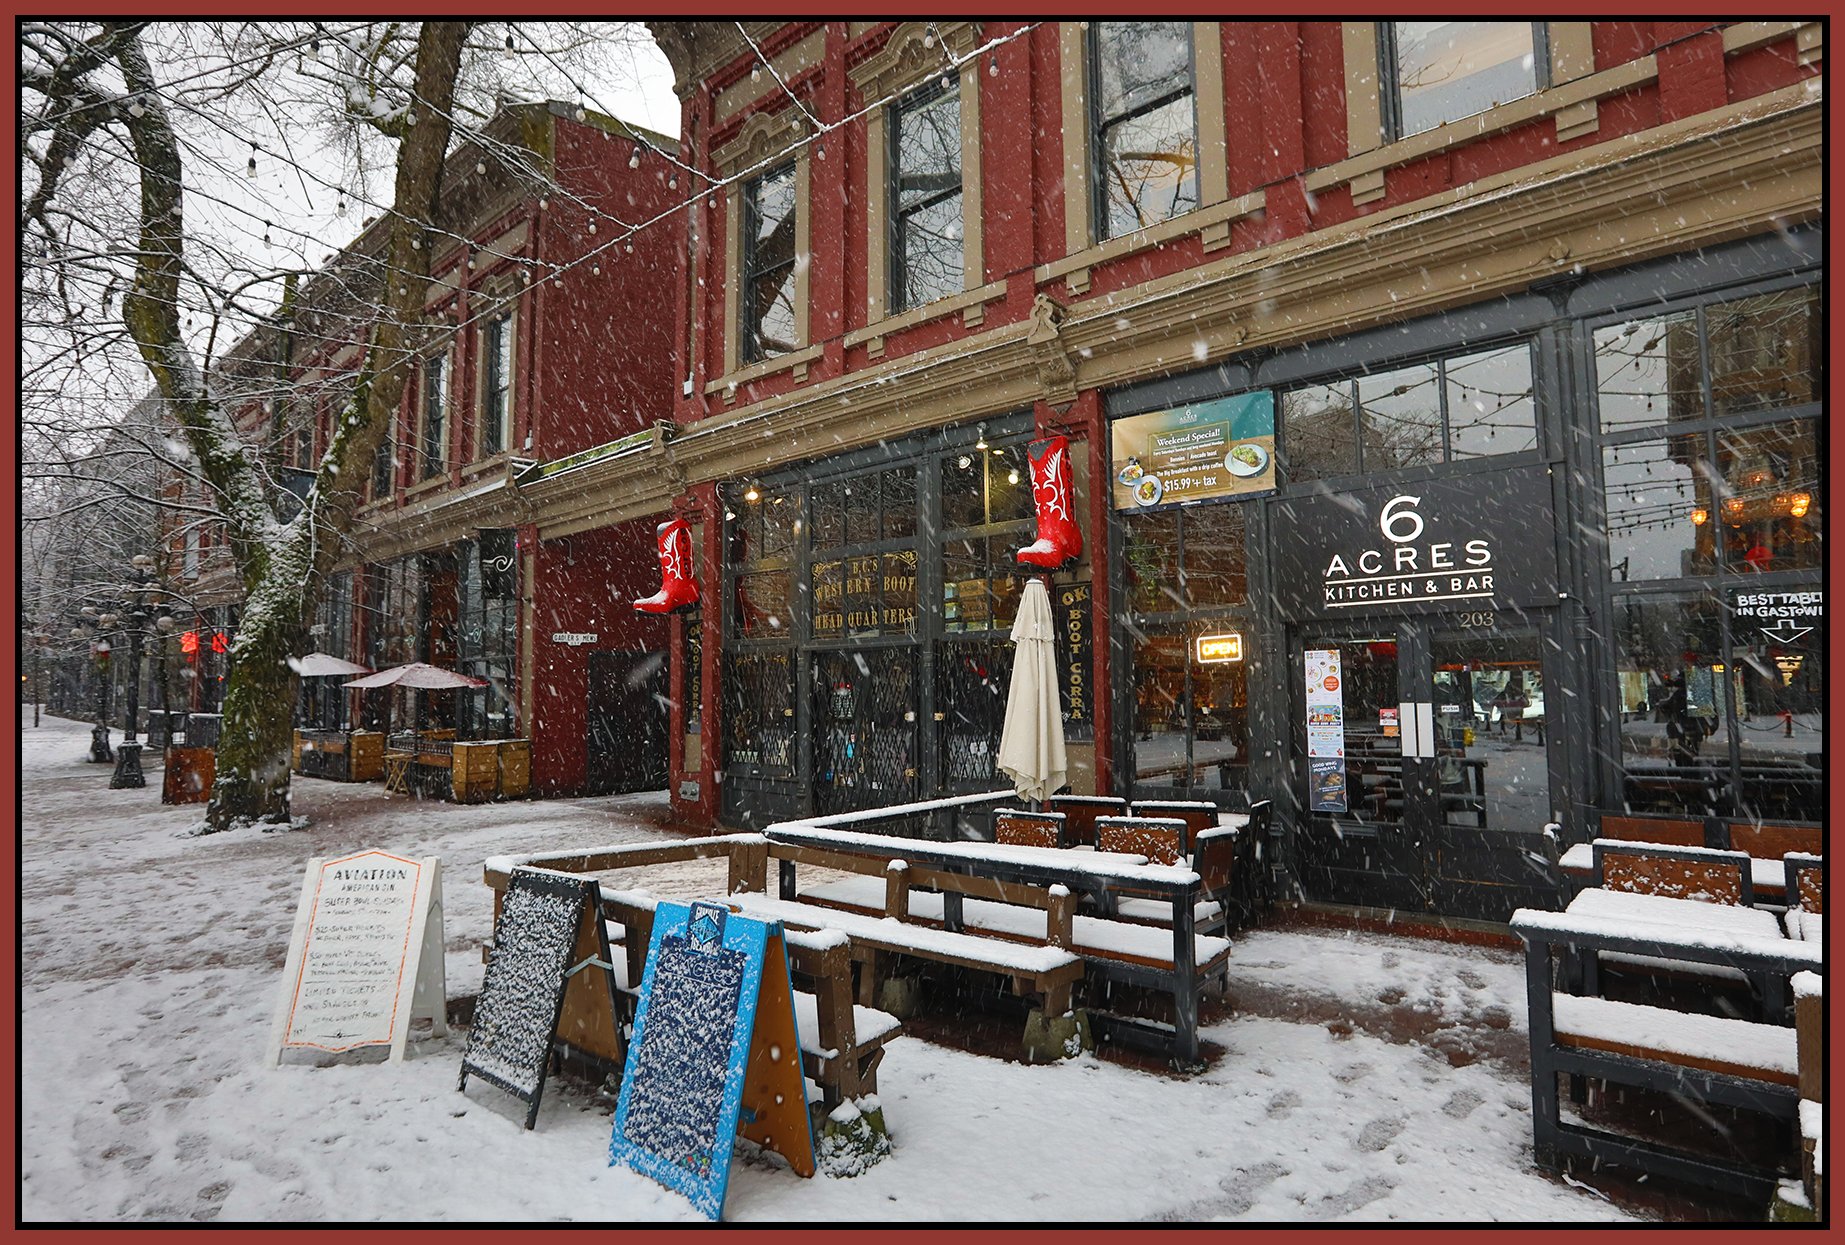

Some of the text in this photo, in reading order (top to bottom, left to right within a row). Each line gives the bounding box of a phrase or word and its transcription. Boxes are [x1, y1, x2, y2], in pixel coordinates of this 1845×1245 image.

[1157, 428, 1221, 446] Weekend Special!
[1171, 467, 1189, 475] Breakfast
[1164, 477, 1191, 492] $15.99
[1203, 476, 1217, 486] tax
[1380, 495, 1424, 543] 6
[1326, 540, 1491, 578] ACRES
[815, 576, 916, 601] WESTERN BOOT
[1062, 586, 1087, 606] OK
[1325, 576, 1494, 601] KITCHEN & BAR
[1737, 593, 1777, 607] BEST
[1460, 612, 1494, 628] 203
[1737, 607, 1754, 616] IN
[815, 613, 843, 630] HEAD
[1069, 609, 1082, 654] BOOT
[1202, 642, 1237, 656] OPEN
[334, 869, 407, 881] AVIATION
